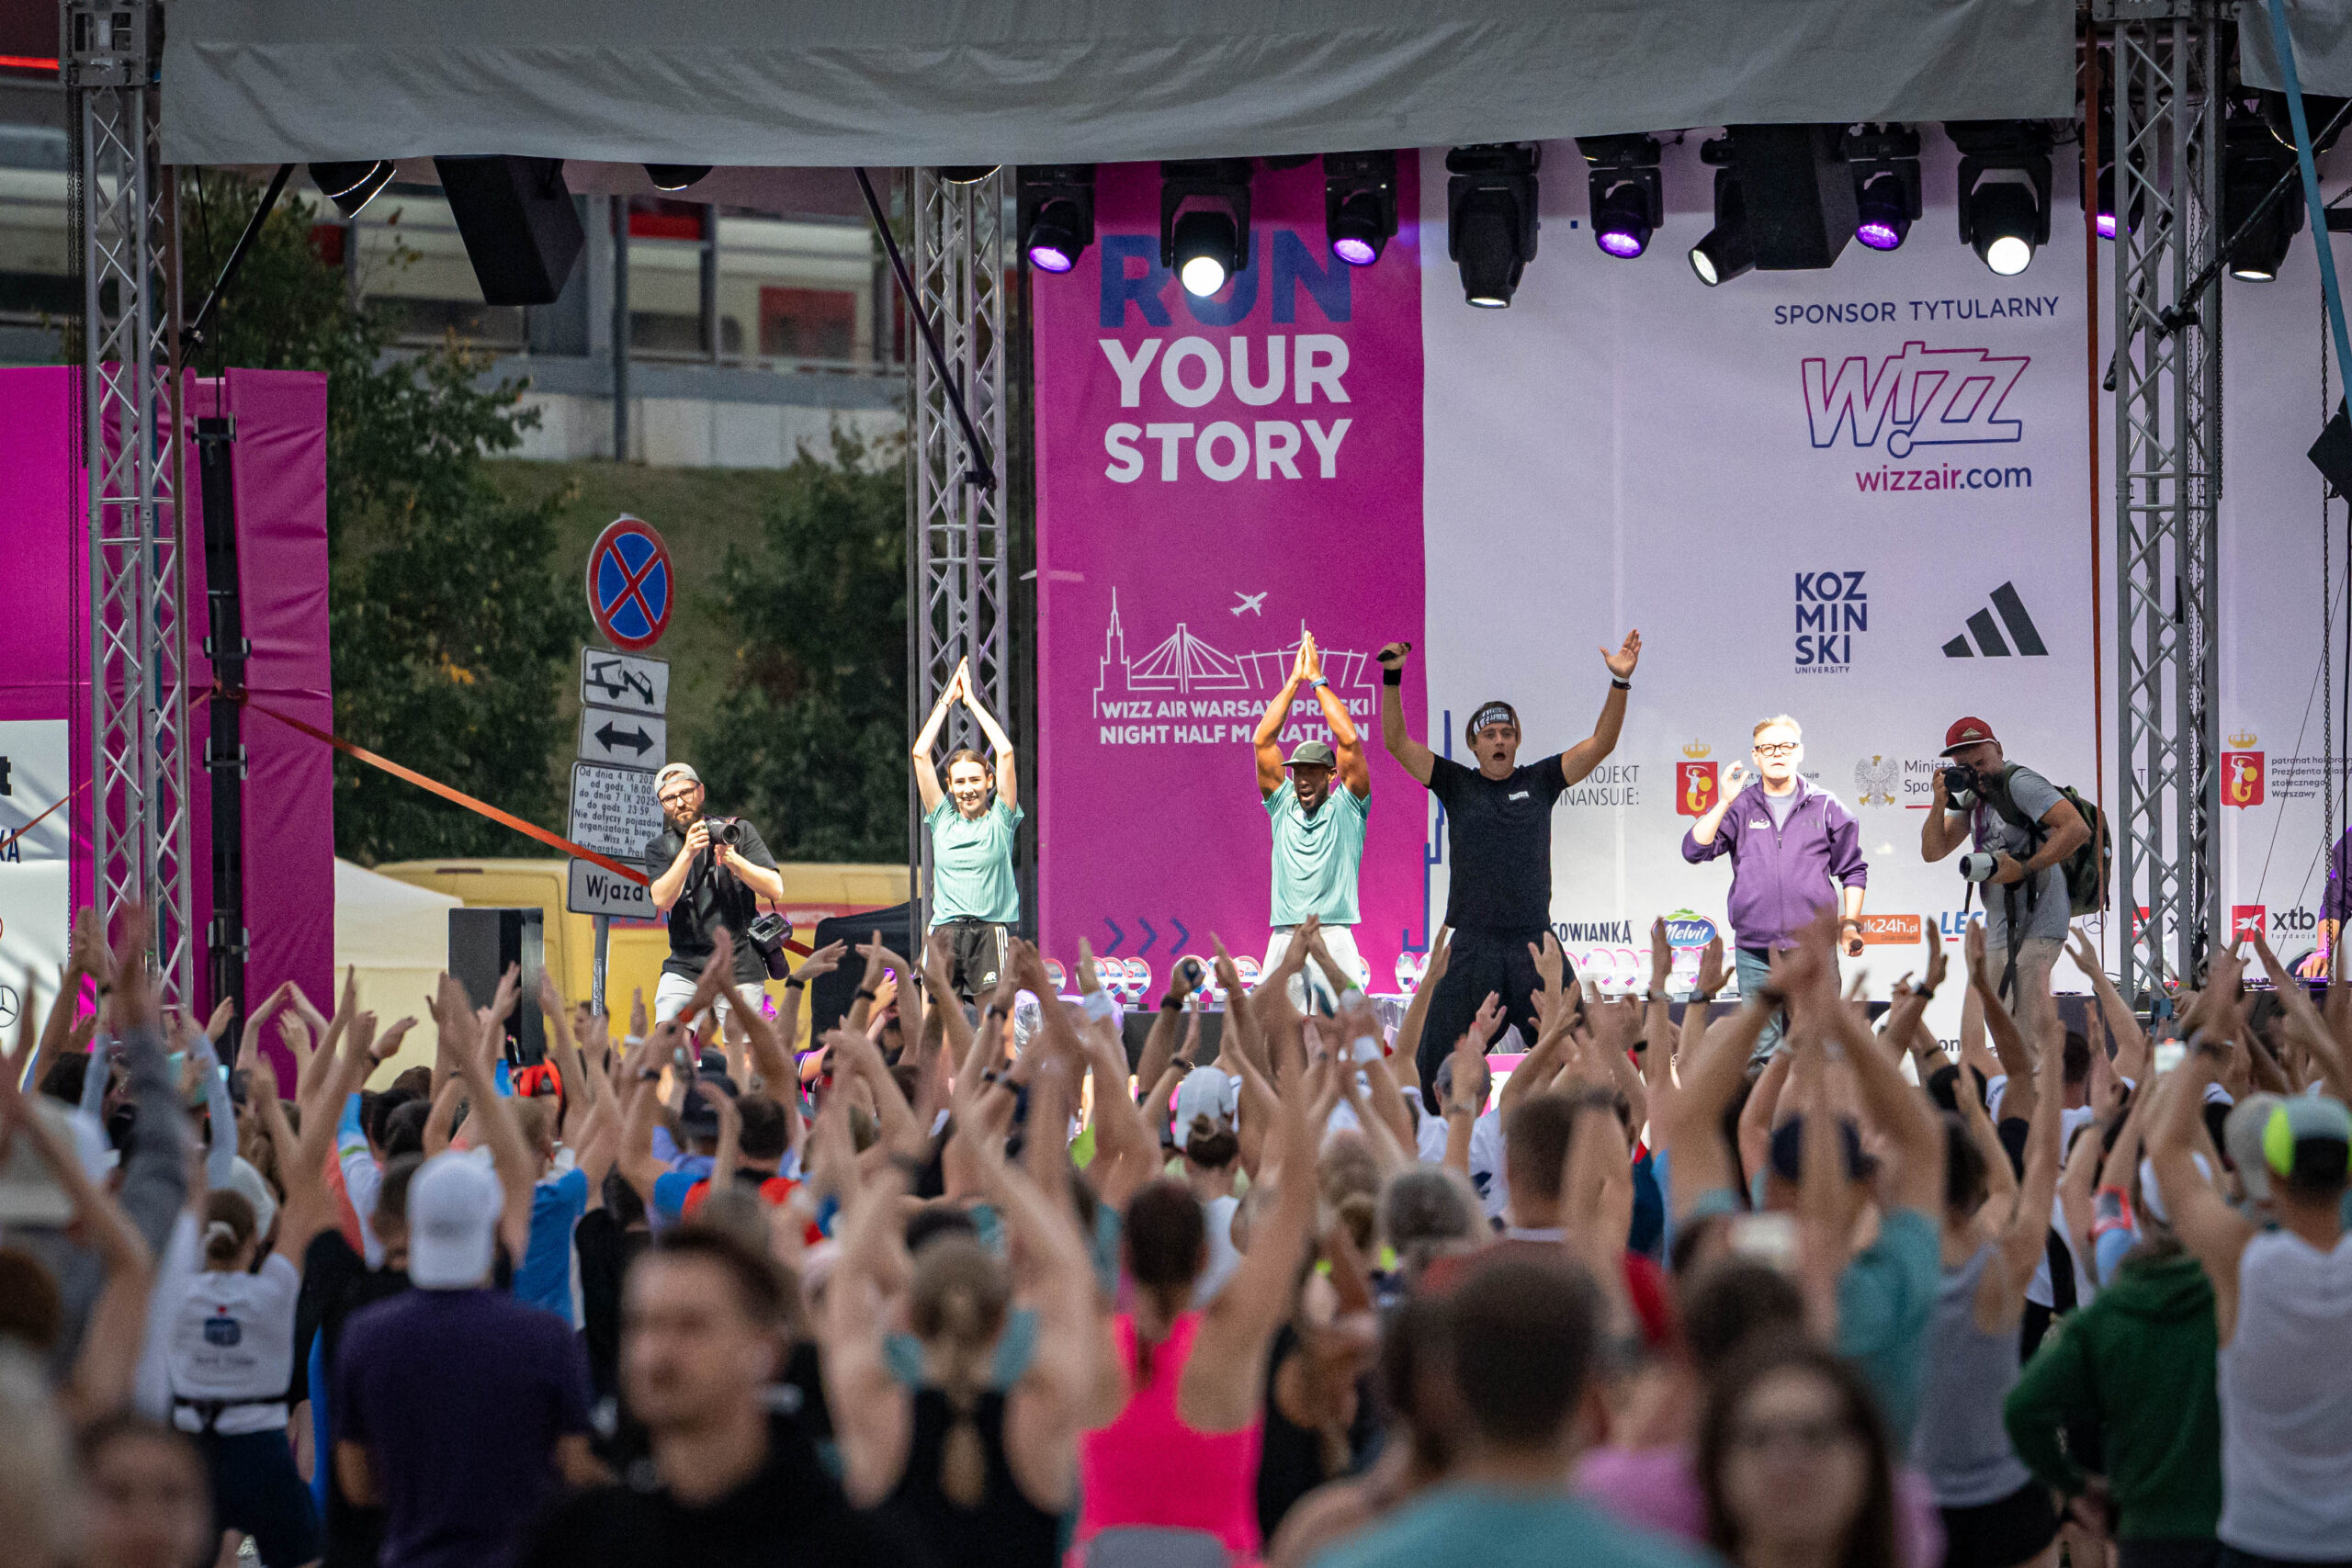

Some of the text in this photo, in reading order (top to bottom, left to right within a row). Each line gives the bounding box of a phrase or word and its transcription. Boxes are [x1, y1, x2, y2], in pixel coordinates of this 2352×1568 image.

[1100, 230, 1352, 328] RUN
[1774, 296, 2059, 324] SPONSOR TYTULARNY
[1098, 334, 1351, 408] YOUR
[1104, 419, 1352, 483] STORY
[1856, 463, 2031, 492] wizzair.com
[1795, 571, 1867, 602] KOZ
[1796, 603, 1867, 633] MIN
[1795, 635, 1850, 665] SKI
[1794, 666, 1850, 674] UNIVERSITY
[1101, 698, 1369, 718] WIZZ AIR WARSA PRSKI
[1101, 723, 1369, 744] NIGHT HALF MATHN
[2272, 757, 2311, 766] patronat
[579, 767, 653, 785] Od dnia 4 IX 202
[1585, 765, 1640, 784] OJEKT
[2272, 767, 2322, 777] Prezydenta
[579, 788, 589, 798] do
[594, 790, 612, 801] dnia
[616, 793, 620, 802] 7
[624, 794, 631, 803] IX
[591, 781, 601, 789] od
[605, 782, 626, 793] godz.
[1559, 787, 1639, 806] INANSUJE:
[1905, 779, 1934, 795] Spor
[2272, 790, 2316, 799] Warszawy
[586, 800, 597, 809] do
[574, 808, 588, 819] Nie
[592, 810, 621, 825] dotyczy
[579, 822, 656, 840] organizatora biegu
[625, 836, 636, 846] Air
[585, 874, 643, 906] Wjazd
[2272, 906, 2315, 931] xtb
[1666, 923, 1709, 942] Melvit
